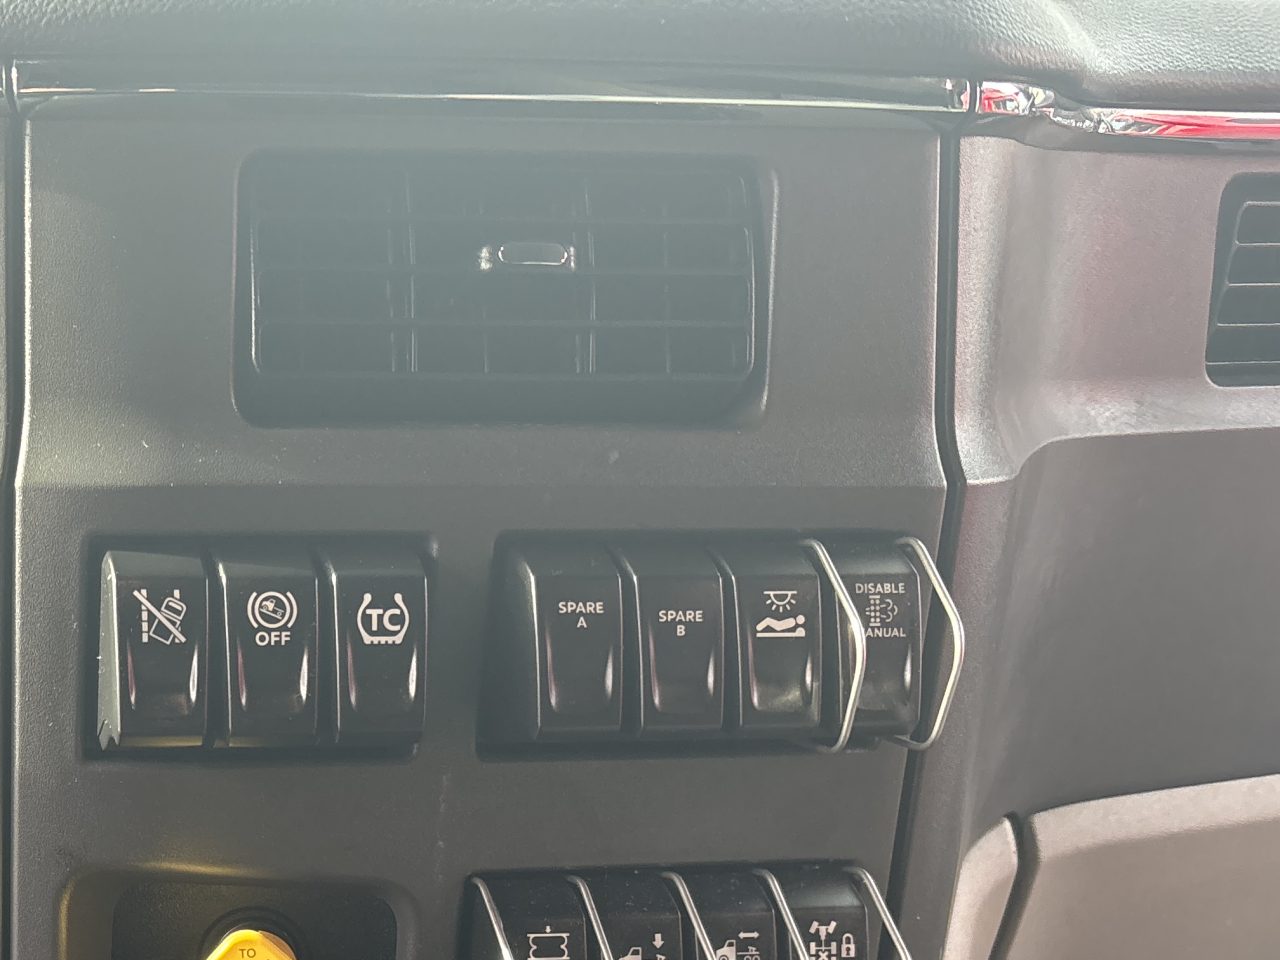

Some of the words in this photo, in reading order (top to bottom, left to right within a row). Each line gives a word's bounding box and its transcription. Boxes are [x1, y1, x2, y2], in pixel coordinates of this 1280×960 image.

[855, 583, 905, 594] DISABLE
[558, 602, 604, 614] SPARE
[366, 608, 401, 632] TC
[658, 610, 703, 622] SPARE
[576, 617, 588, 628] A
[676, 625, 686, 636] B
[864, 627, 906, 638] ANUAL
[255, 631, 291, 647] OFF
[239, 948, 257, 959] TO
